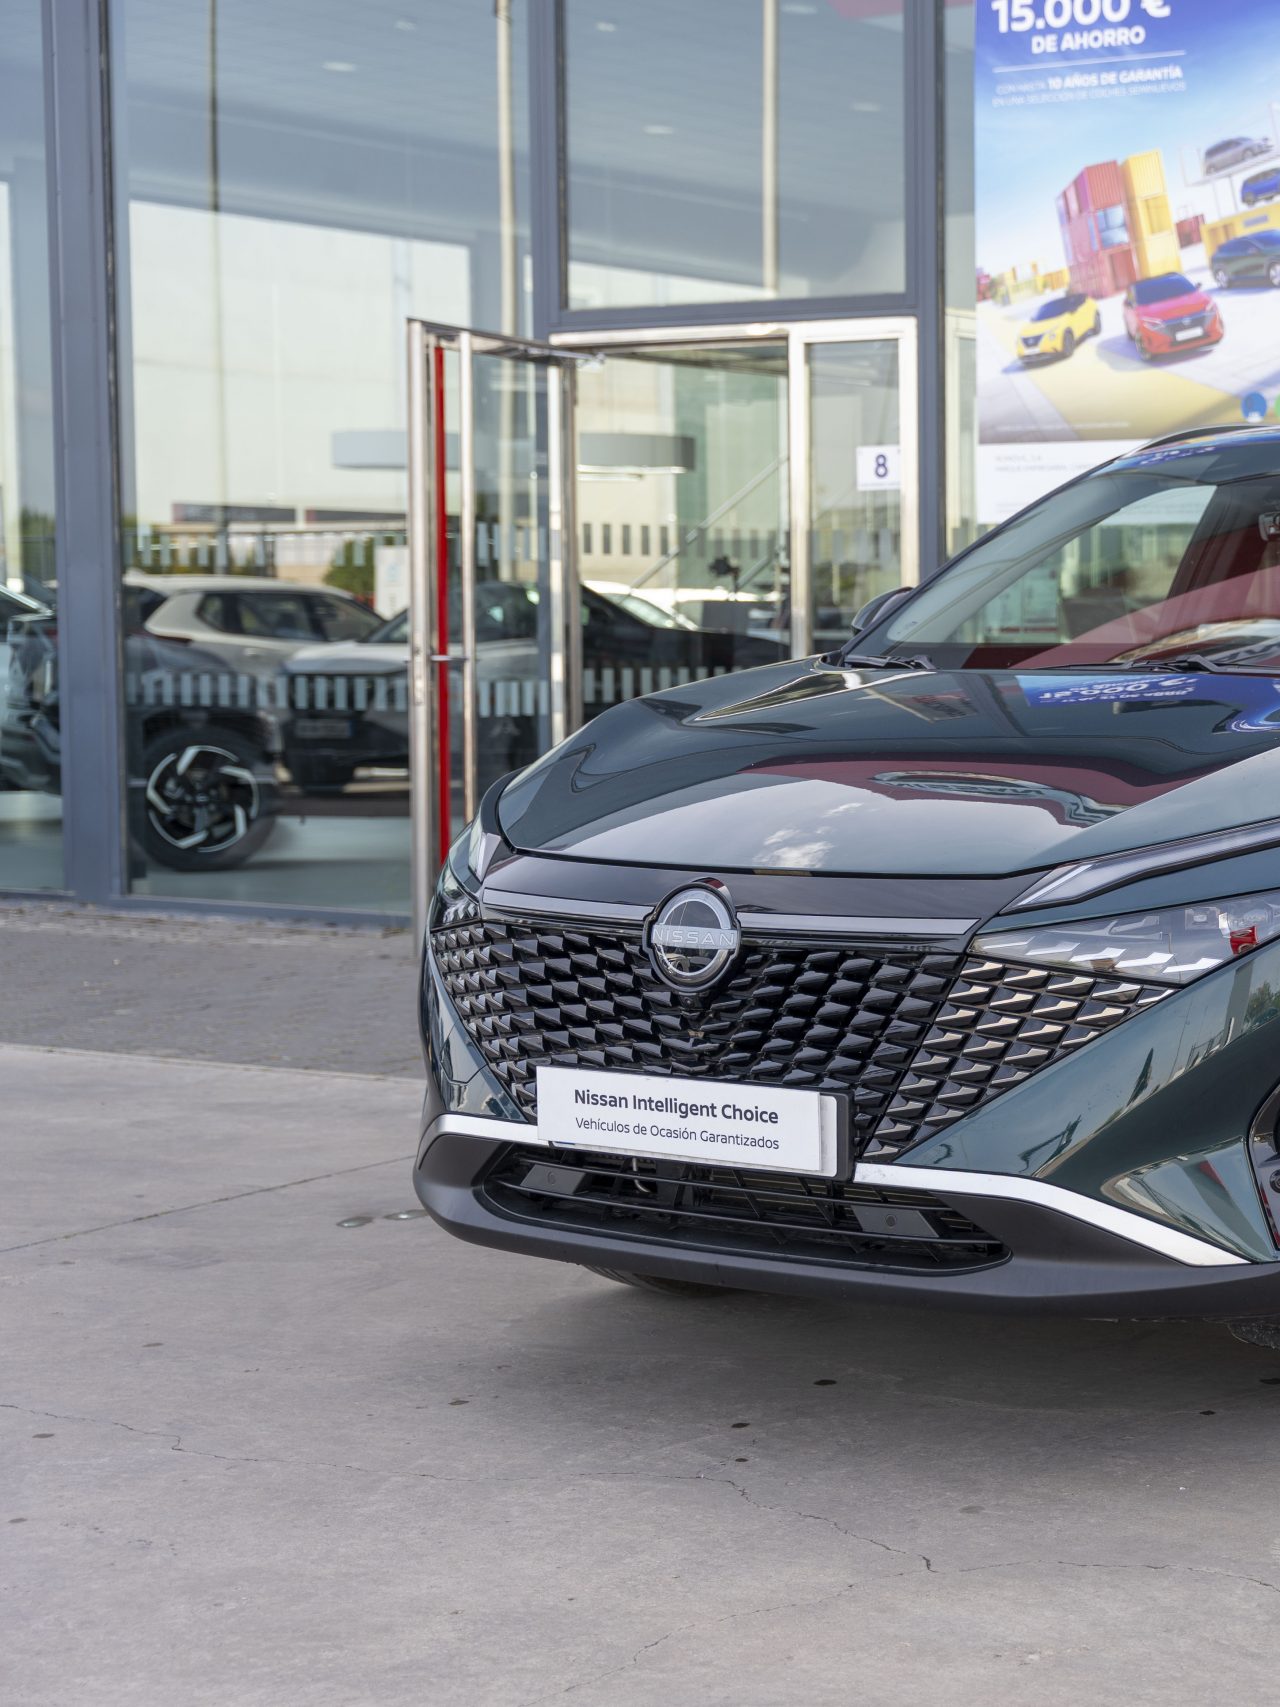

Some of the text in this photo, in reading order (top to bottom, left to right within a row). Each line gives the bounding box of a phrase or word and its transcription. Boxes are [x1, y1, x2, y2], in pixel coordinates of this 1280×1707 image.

[1031, 25, 1146, 54] DE AHORRO
[874, 454, 888, 478] 8
[653, 929, 735, 946] NISSAN
[574, 1089, 779, 1124] Nissan Intelligent Choice
[575, 1117, 780, 1149] Vehículos de Ocasión Garantizados
